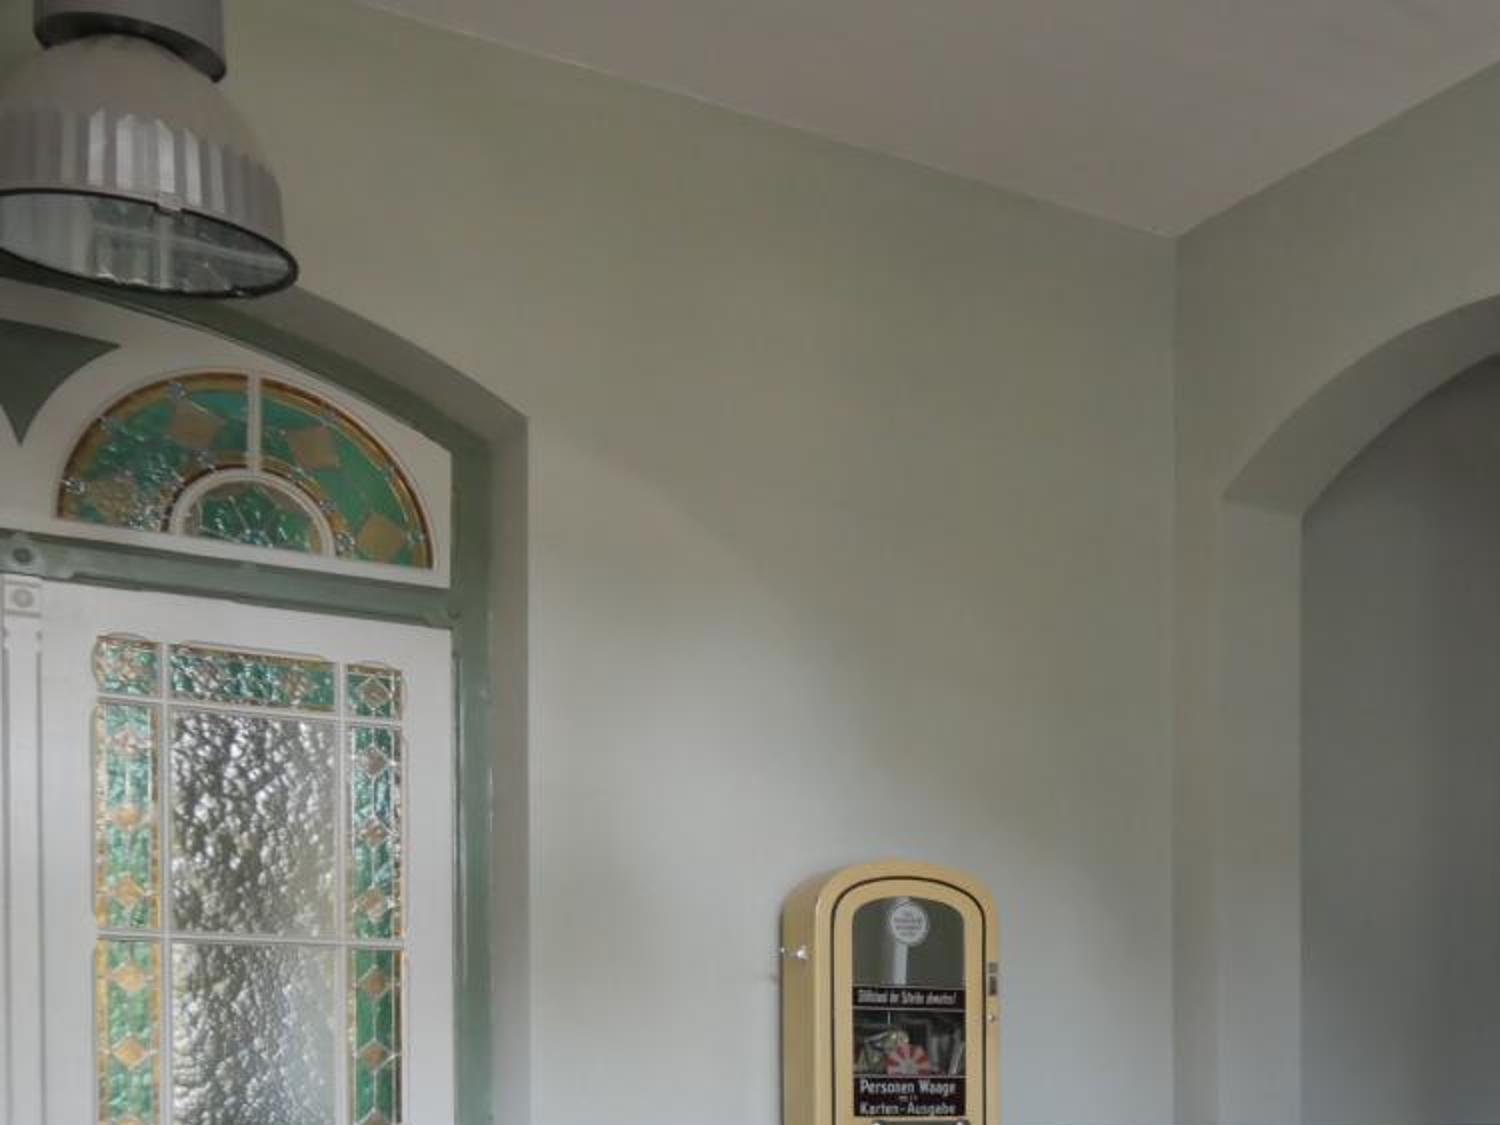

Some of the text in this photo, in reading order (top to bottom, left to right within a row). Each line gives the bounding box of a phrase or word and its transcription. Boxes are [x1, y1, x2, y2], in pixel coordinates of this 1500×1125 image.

[860, 1079, 956, 1097] Personen Waage
[860, 1102, 956, 1117] Karten-Ausgabe
